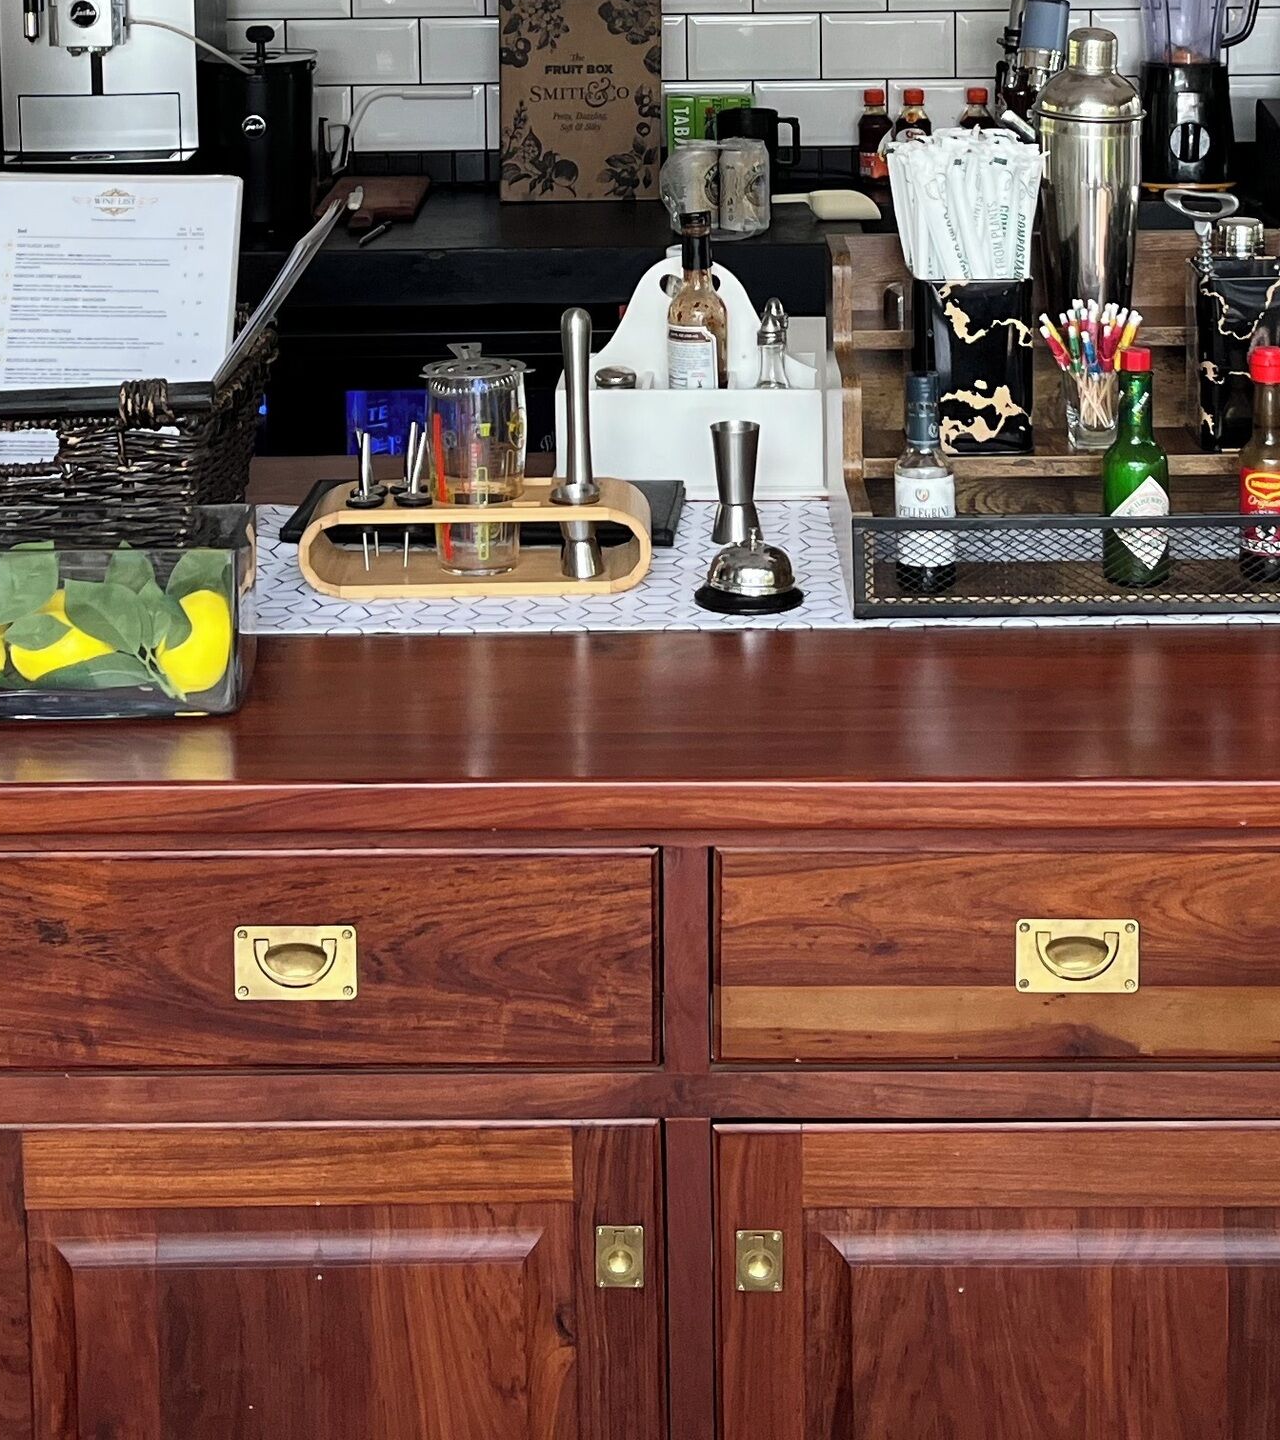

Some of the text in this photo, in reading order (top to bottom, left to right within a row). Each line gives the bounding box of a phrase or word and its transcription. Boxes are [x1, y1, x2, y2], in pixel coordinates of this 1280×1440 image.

[570, 53, 585, 61] The
[545, 64, 613, 74] FRUIT BOX
[94, 197, 136, 205] WINE LIST
[987, 200, 1002, 242] PLANTS
[992, 239, 1007, 269] FROM
